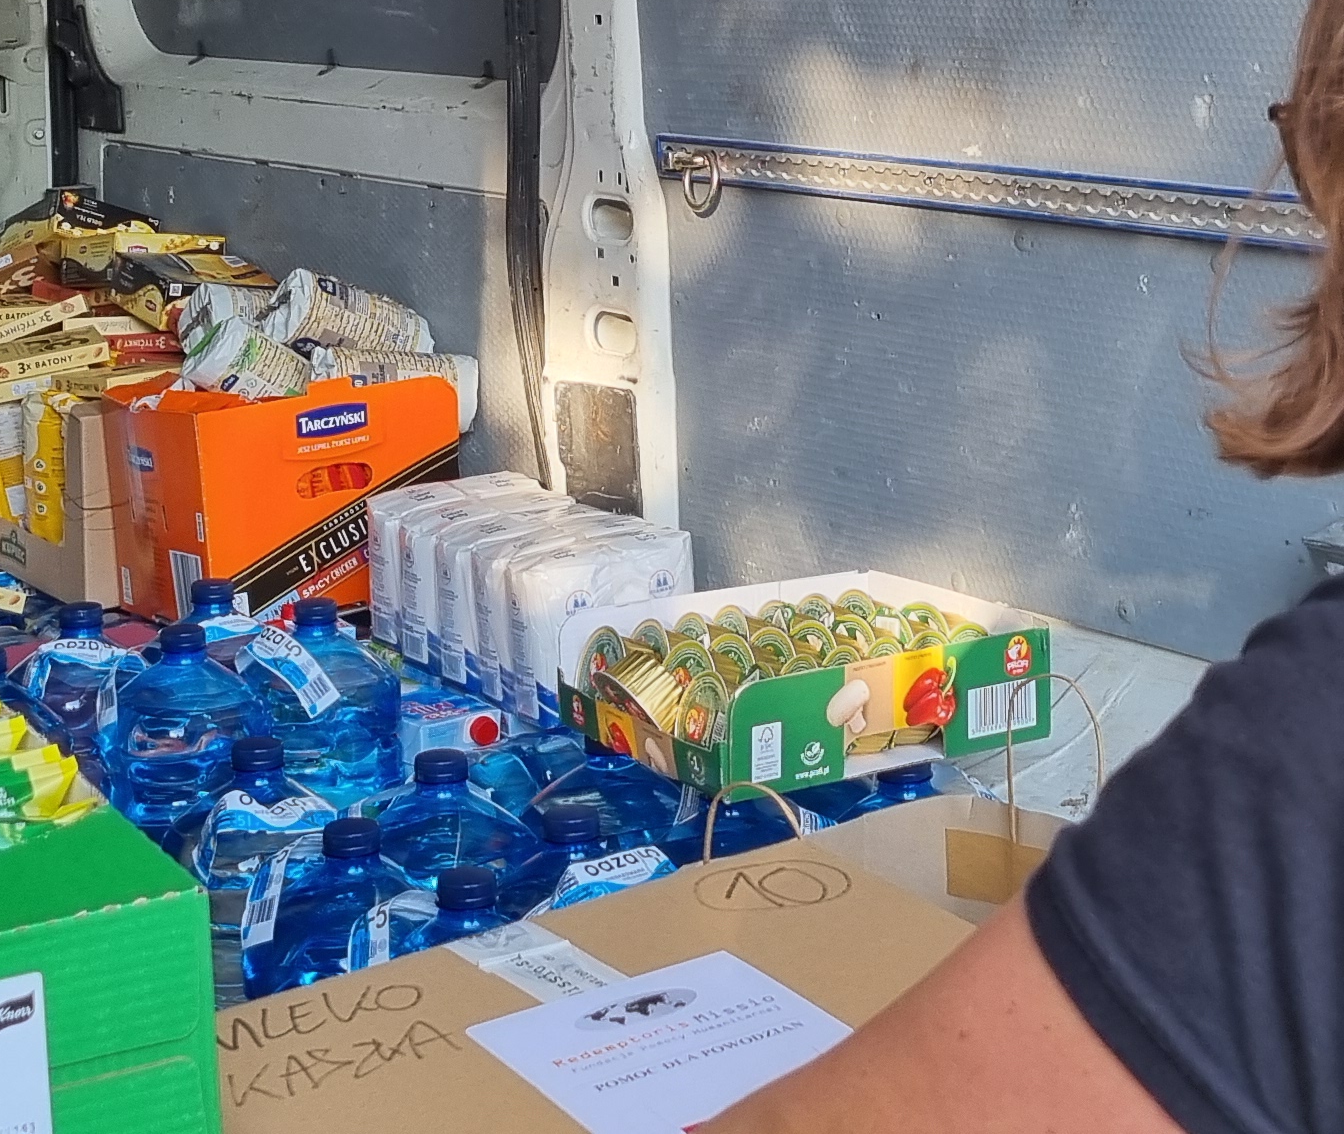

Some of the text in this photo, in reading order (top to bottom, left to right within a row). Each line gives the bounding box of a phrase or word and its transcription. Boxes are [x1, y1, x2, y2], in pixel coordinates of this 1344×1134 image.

[17, 354, 73, 375] 3x BATONY
[299, 411, 365, 433] TARCZYŃSKI
[302, 557, 358, 598] SPICY CHICKEN
[583, 852, 641, 877] oaza
[552, 993, 776, 1069] Redemptoris Missio
[593, 1020, 805, 1093] POMOC DLA POWODZIAN
